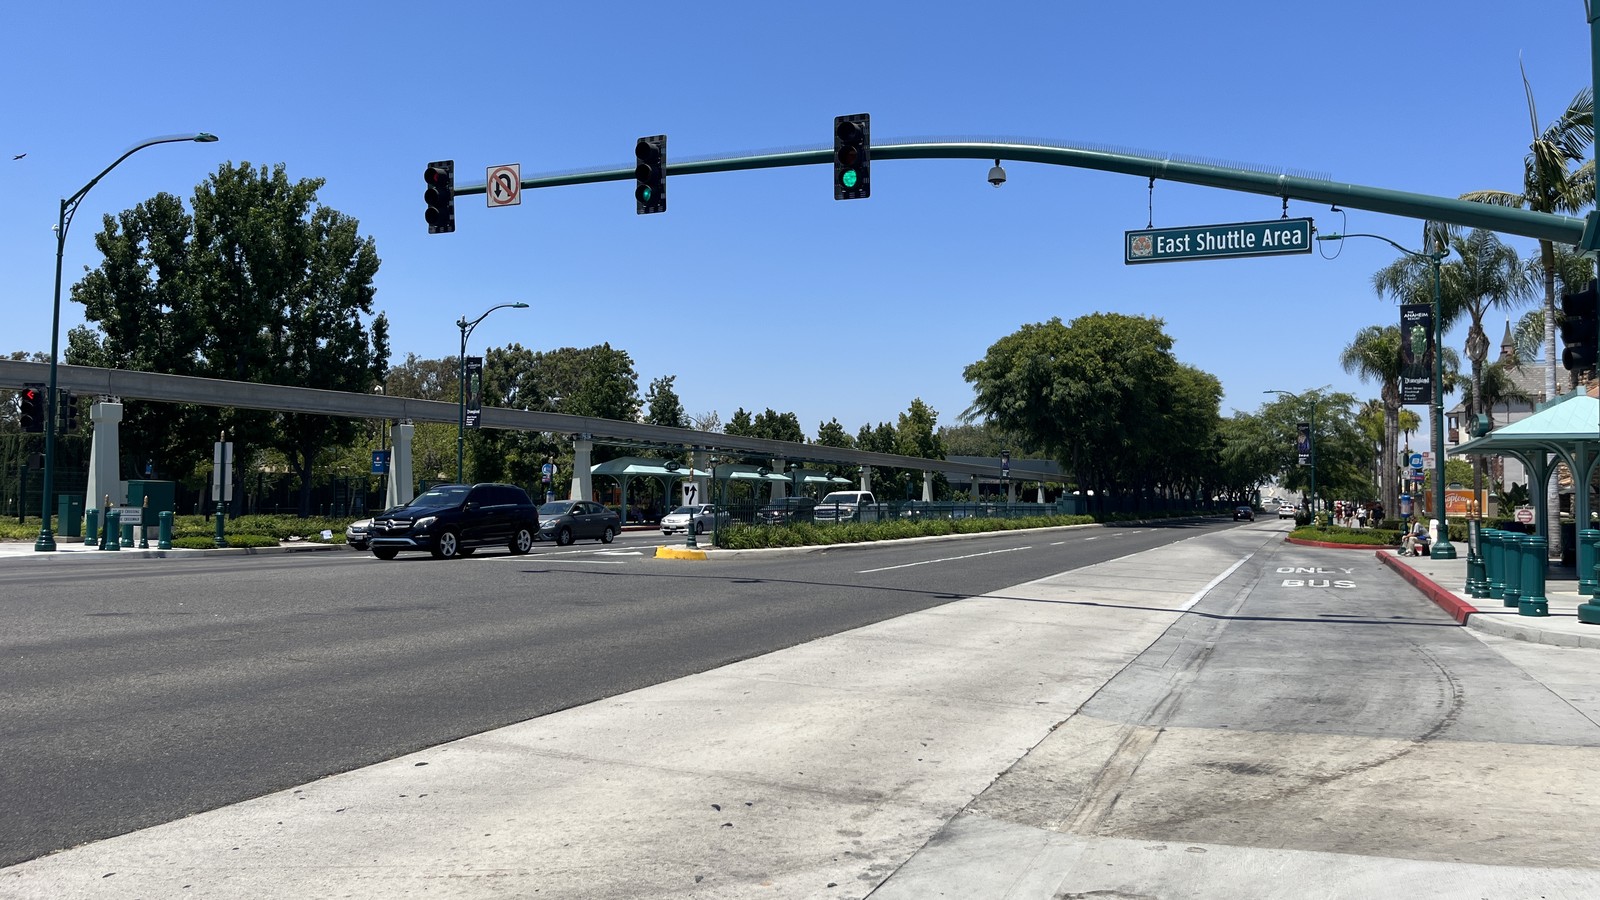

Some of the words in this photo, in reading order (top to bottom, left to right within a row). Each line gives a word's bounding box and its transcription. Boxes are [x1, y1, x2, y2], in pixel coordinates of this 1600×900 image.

[1157, 235, 1190, 254] East
[1196, 229, 1255, 251] Shuttle
[1262, 228, 1302, 247] Area
[1282, 579, 1357, 588] BUS
